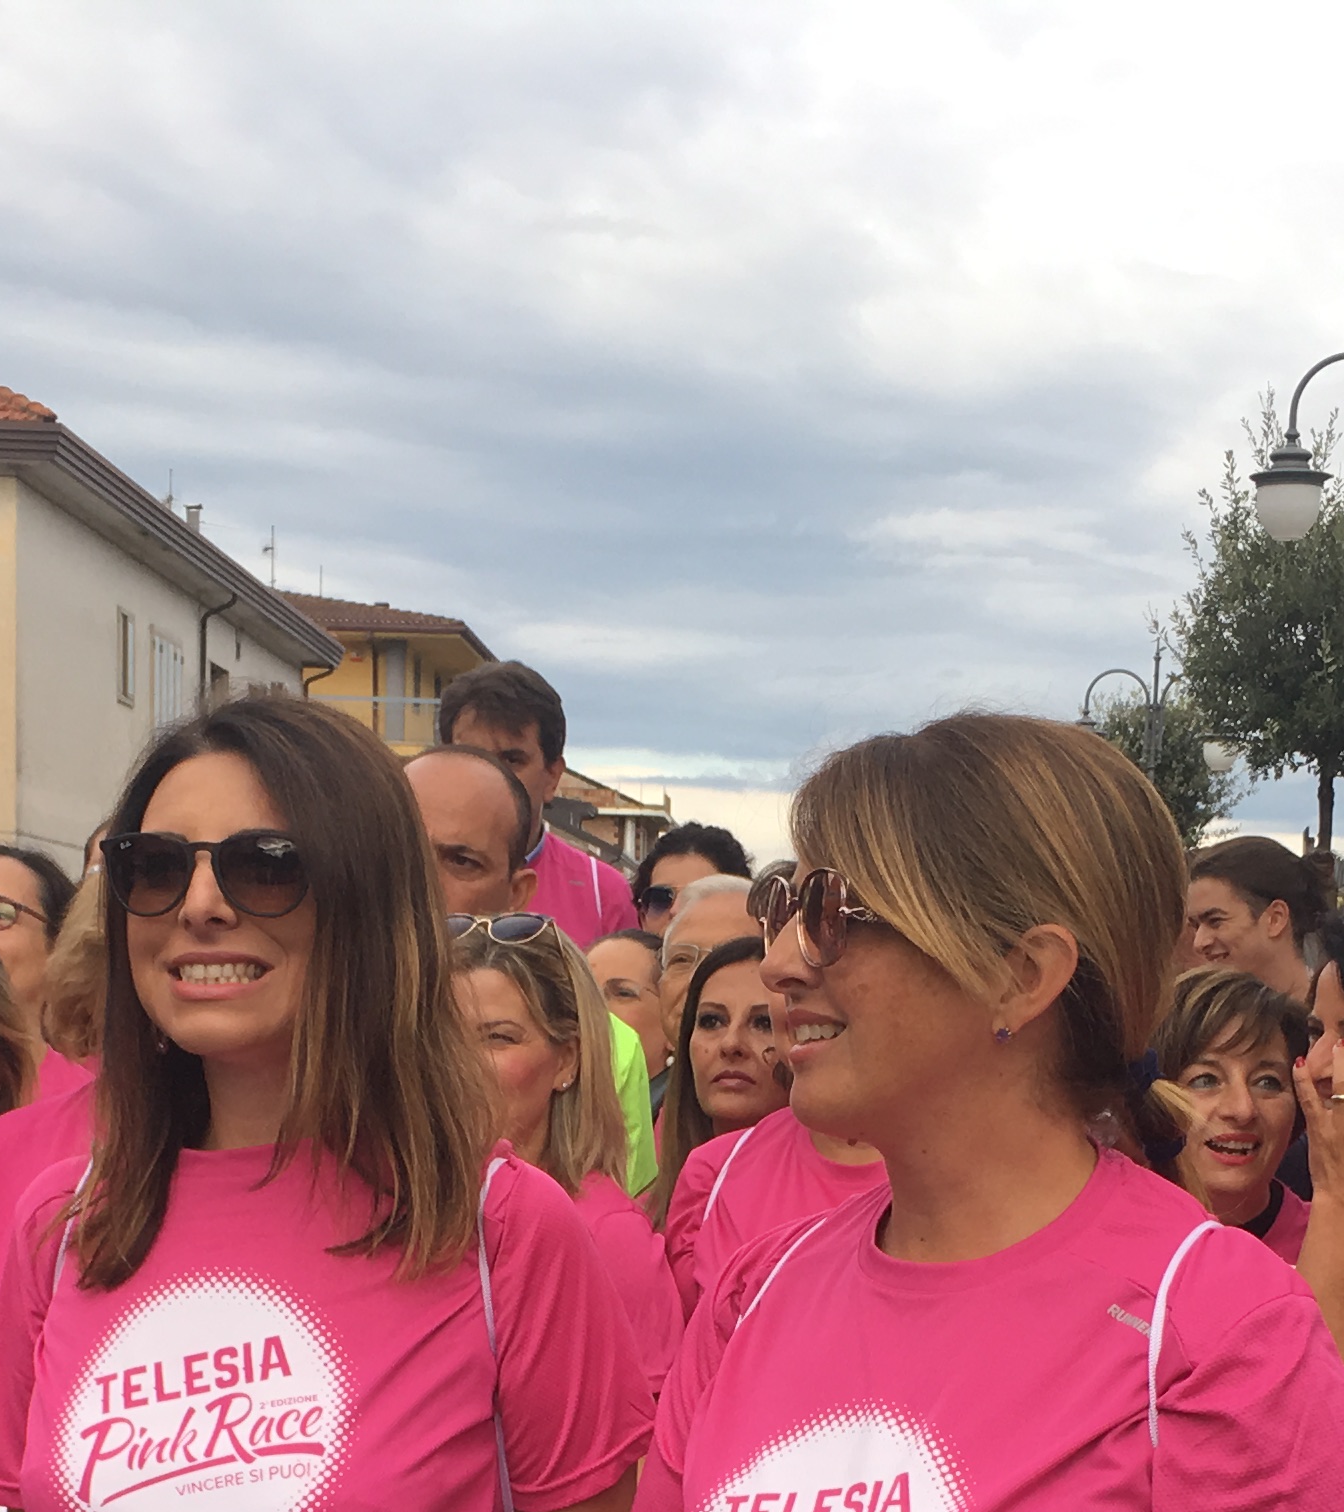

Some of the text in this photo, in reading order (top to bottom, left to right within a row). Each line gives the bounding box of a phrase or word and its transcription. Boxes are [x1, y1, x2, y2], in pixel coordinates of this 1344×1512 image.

[93, 1335, 293, 1415] TELESIA
[270, 1394, 319, 1408] EDIZIONE
[77, 1392, 324, 1504] Pink Race
[175, 1471, 245, 1497] VINCERE
[249, 1468, 265, 1483] SI
